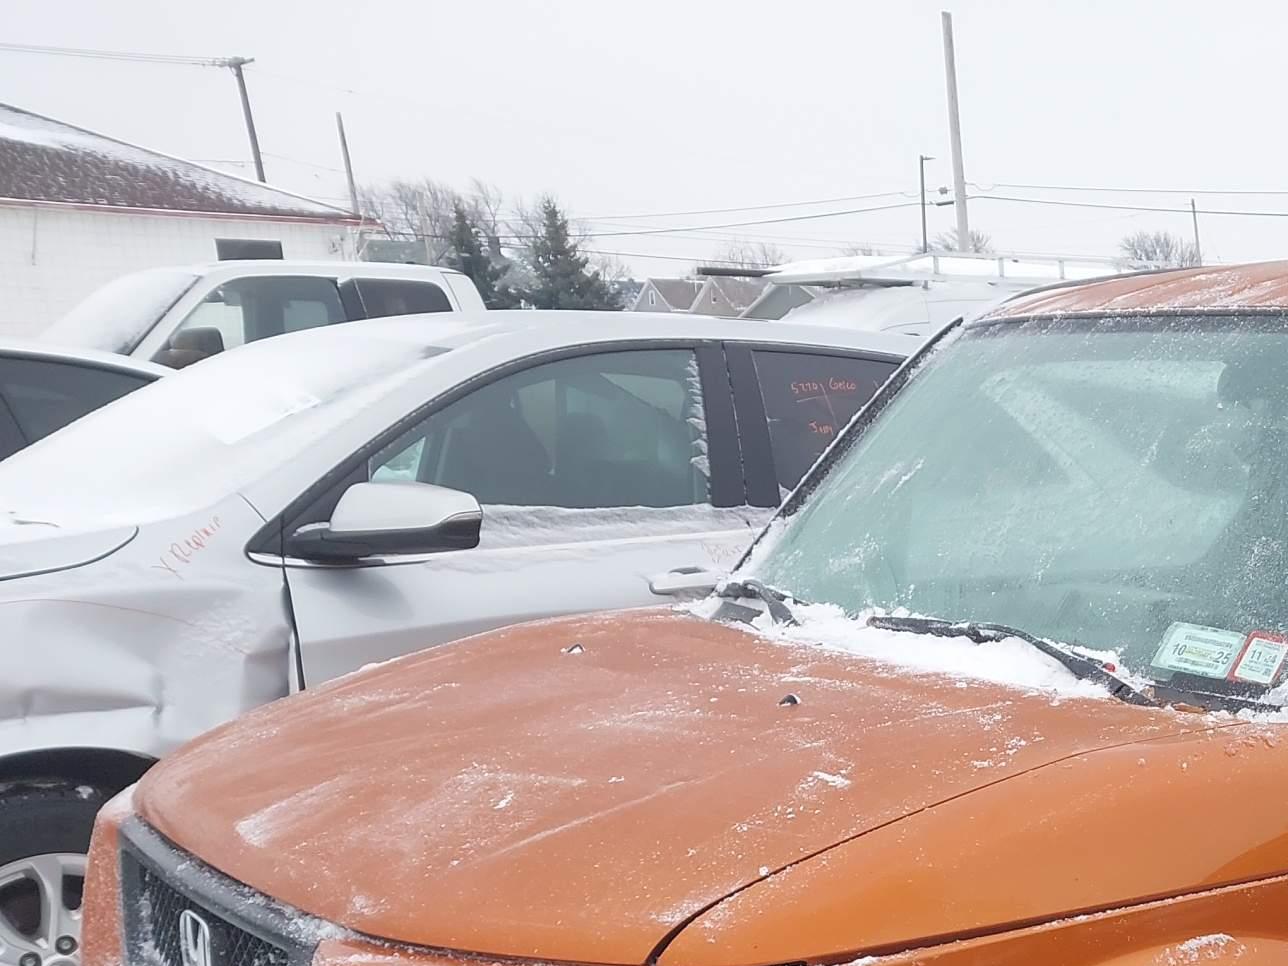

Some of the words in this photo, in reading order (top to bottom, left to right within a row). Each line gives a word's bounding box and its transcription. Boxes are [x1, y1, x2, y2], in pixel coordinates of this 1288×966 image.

[1171, 643, 1188, 656] 10
[1212, 651, 1233, 665] 25
[1250, 649, 1263, 661] 11
